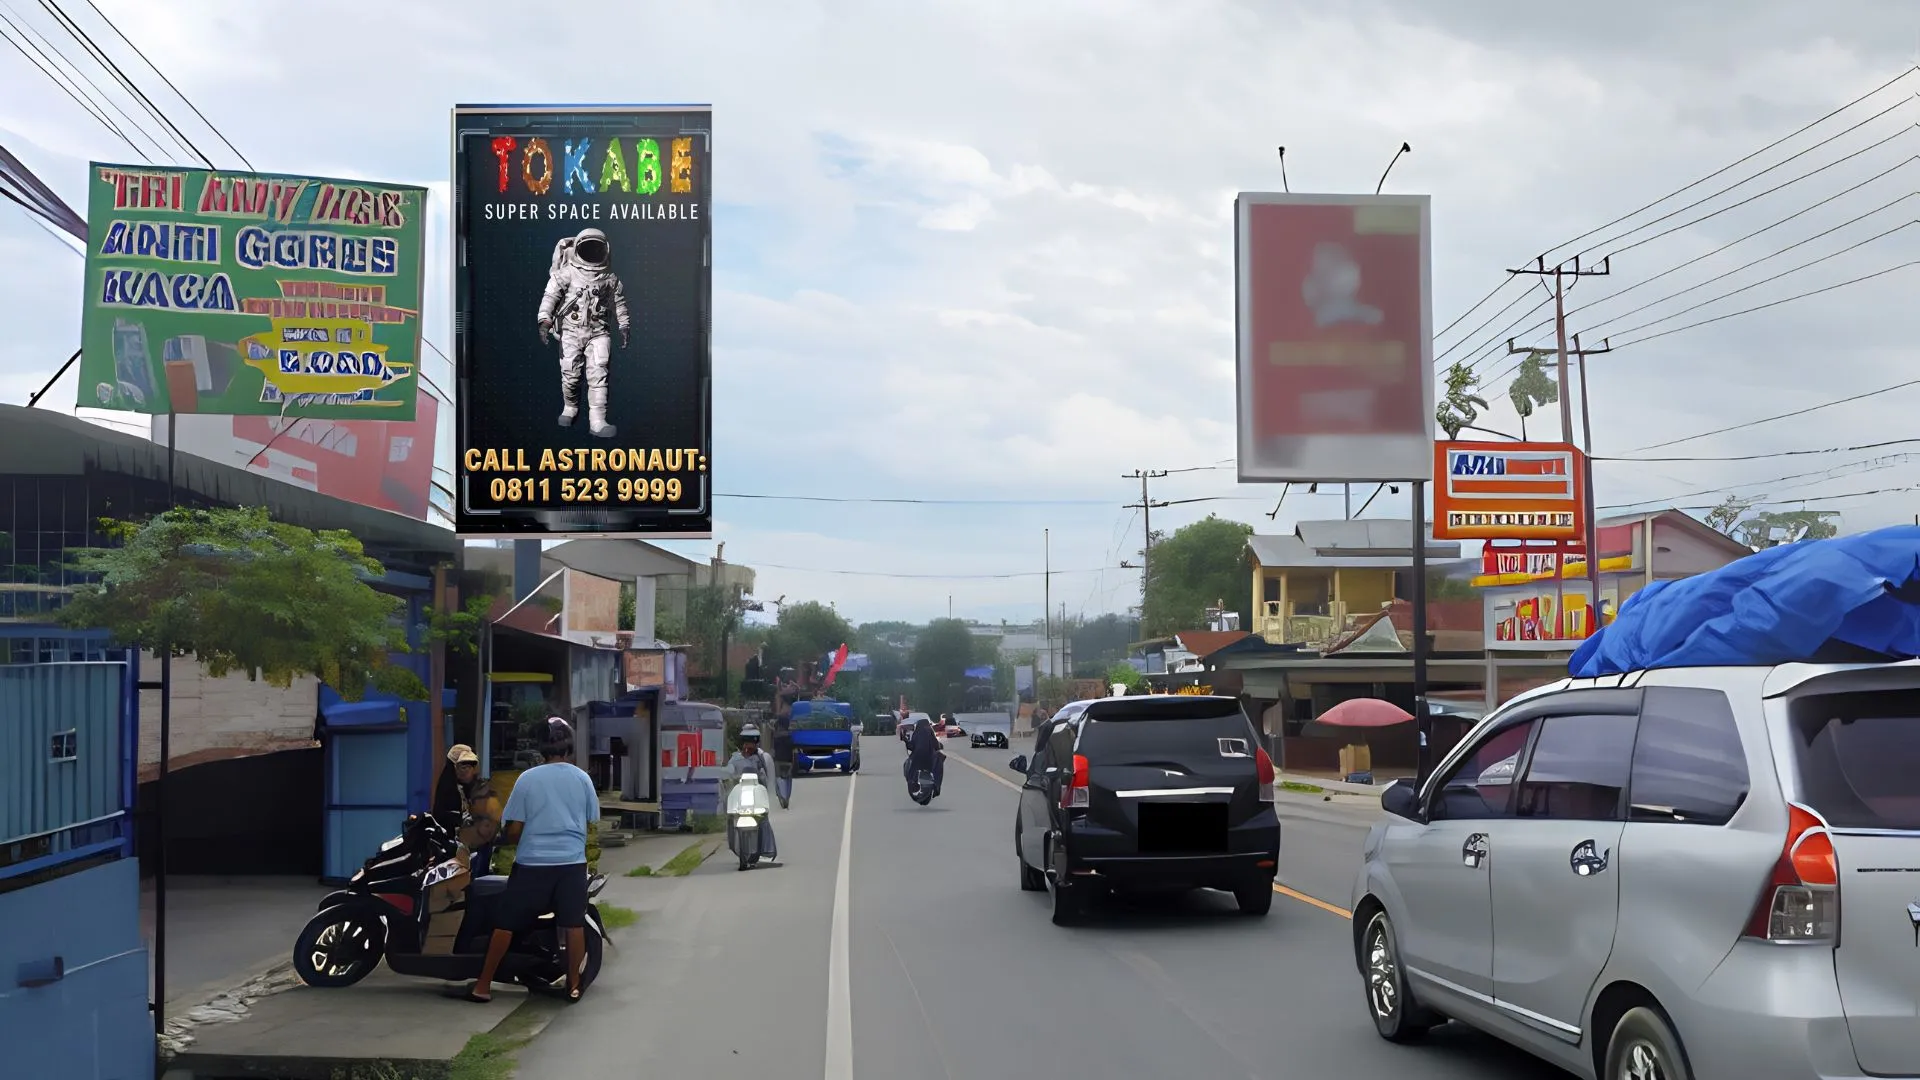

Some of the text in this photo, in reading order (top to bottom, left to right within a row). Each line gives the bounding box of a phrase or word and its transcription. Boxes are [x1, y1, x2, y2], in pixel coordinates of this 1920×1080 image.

[491, 136, 693, 195] TOKABE
[484, 203, 699, 220] SUPER SPACE AVAILABLE
[465, 448, 706, 472] CALL ASTRONAUT:
[490, 478, 682, 502] 0811 523 9999
